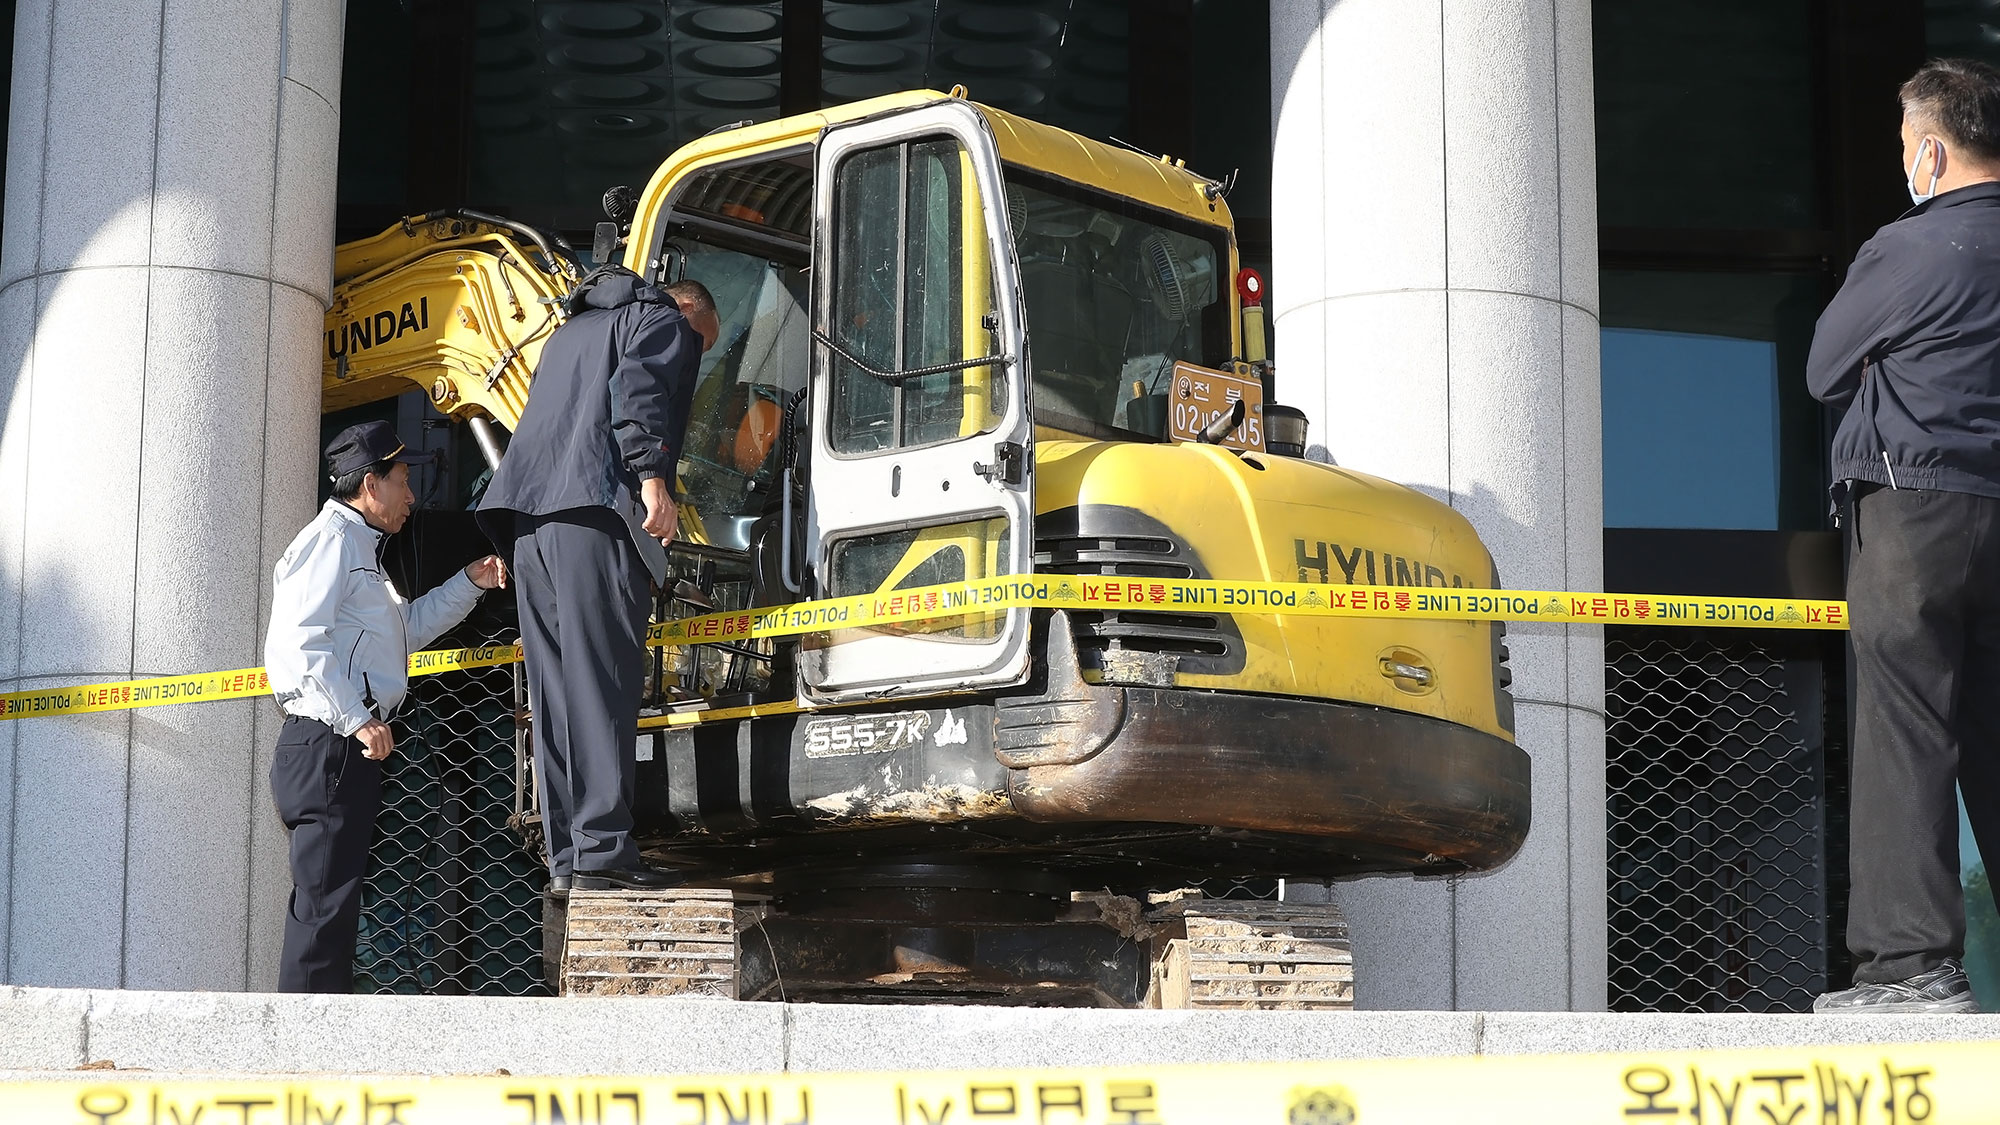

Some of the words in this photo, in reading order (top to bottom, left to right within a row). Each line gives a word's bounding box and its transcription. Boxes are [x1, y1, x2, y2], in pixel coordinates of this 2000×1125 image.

[323, 296, 429, 360] UNDAI
[983, 583, 1048, 604] POLICE
[1083, 582, 1167, 604] 출입금지
[1172, 586, 1217, 603] LINE
[1224, 588, 1296, 606] POLICE
[1330, 590, 1411, 611] 출입금지
[1417, 594, 1461, 611] LINE
[1467, 596, 1538, 614] POLICE
[1571, 597, 1651, 619] 출입금지
[1656, 602, 1699, 619] LINE
[754, 612, 788, 630] LINE
[793, 606, 848, 627] POLICE
[1705, 604, 1774, 621] POLICE
[1806, 605, 1843, 624] 금지
[687, 615, 750, 639] 출입금지
[416, 654, 442, 668] LINE
[447, 648, 495, 664] POLICE
[88, 686, 131, 706] 출입금지
[133, 685, 160, 701] LINE
[162, 680, 204, 698] POLICE
[8, 698, 31, 714] LINE
[34, 694, 70, 712] POLICE
